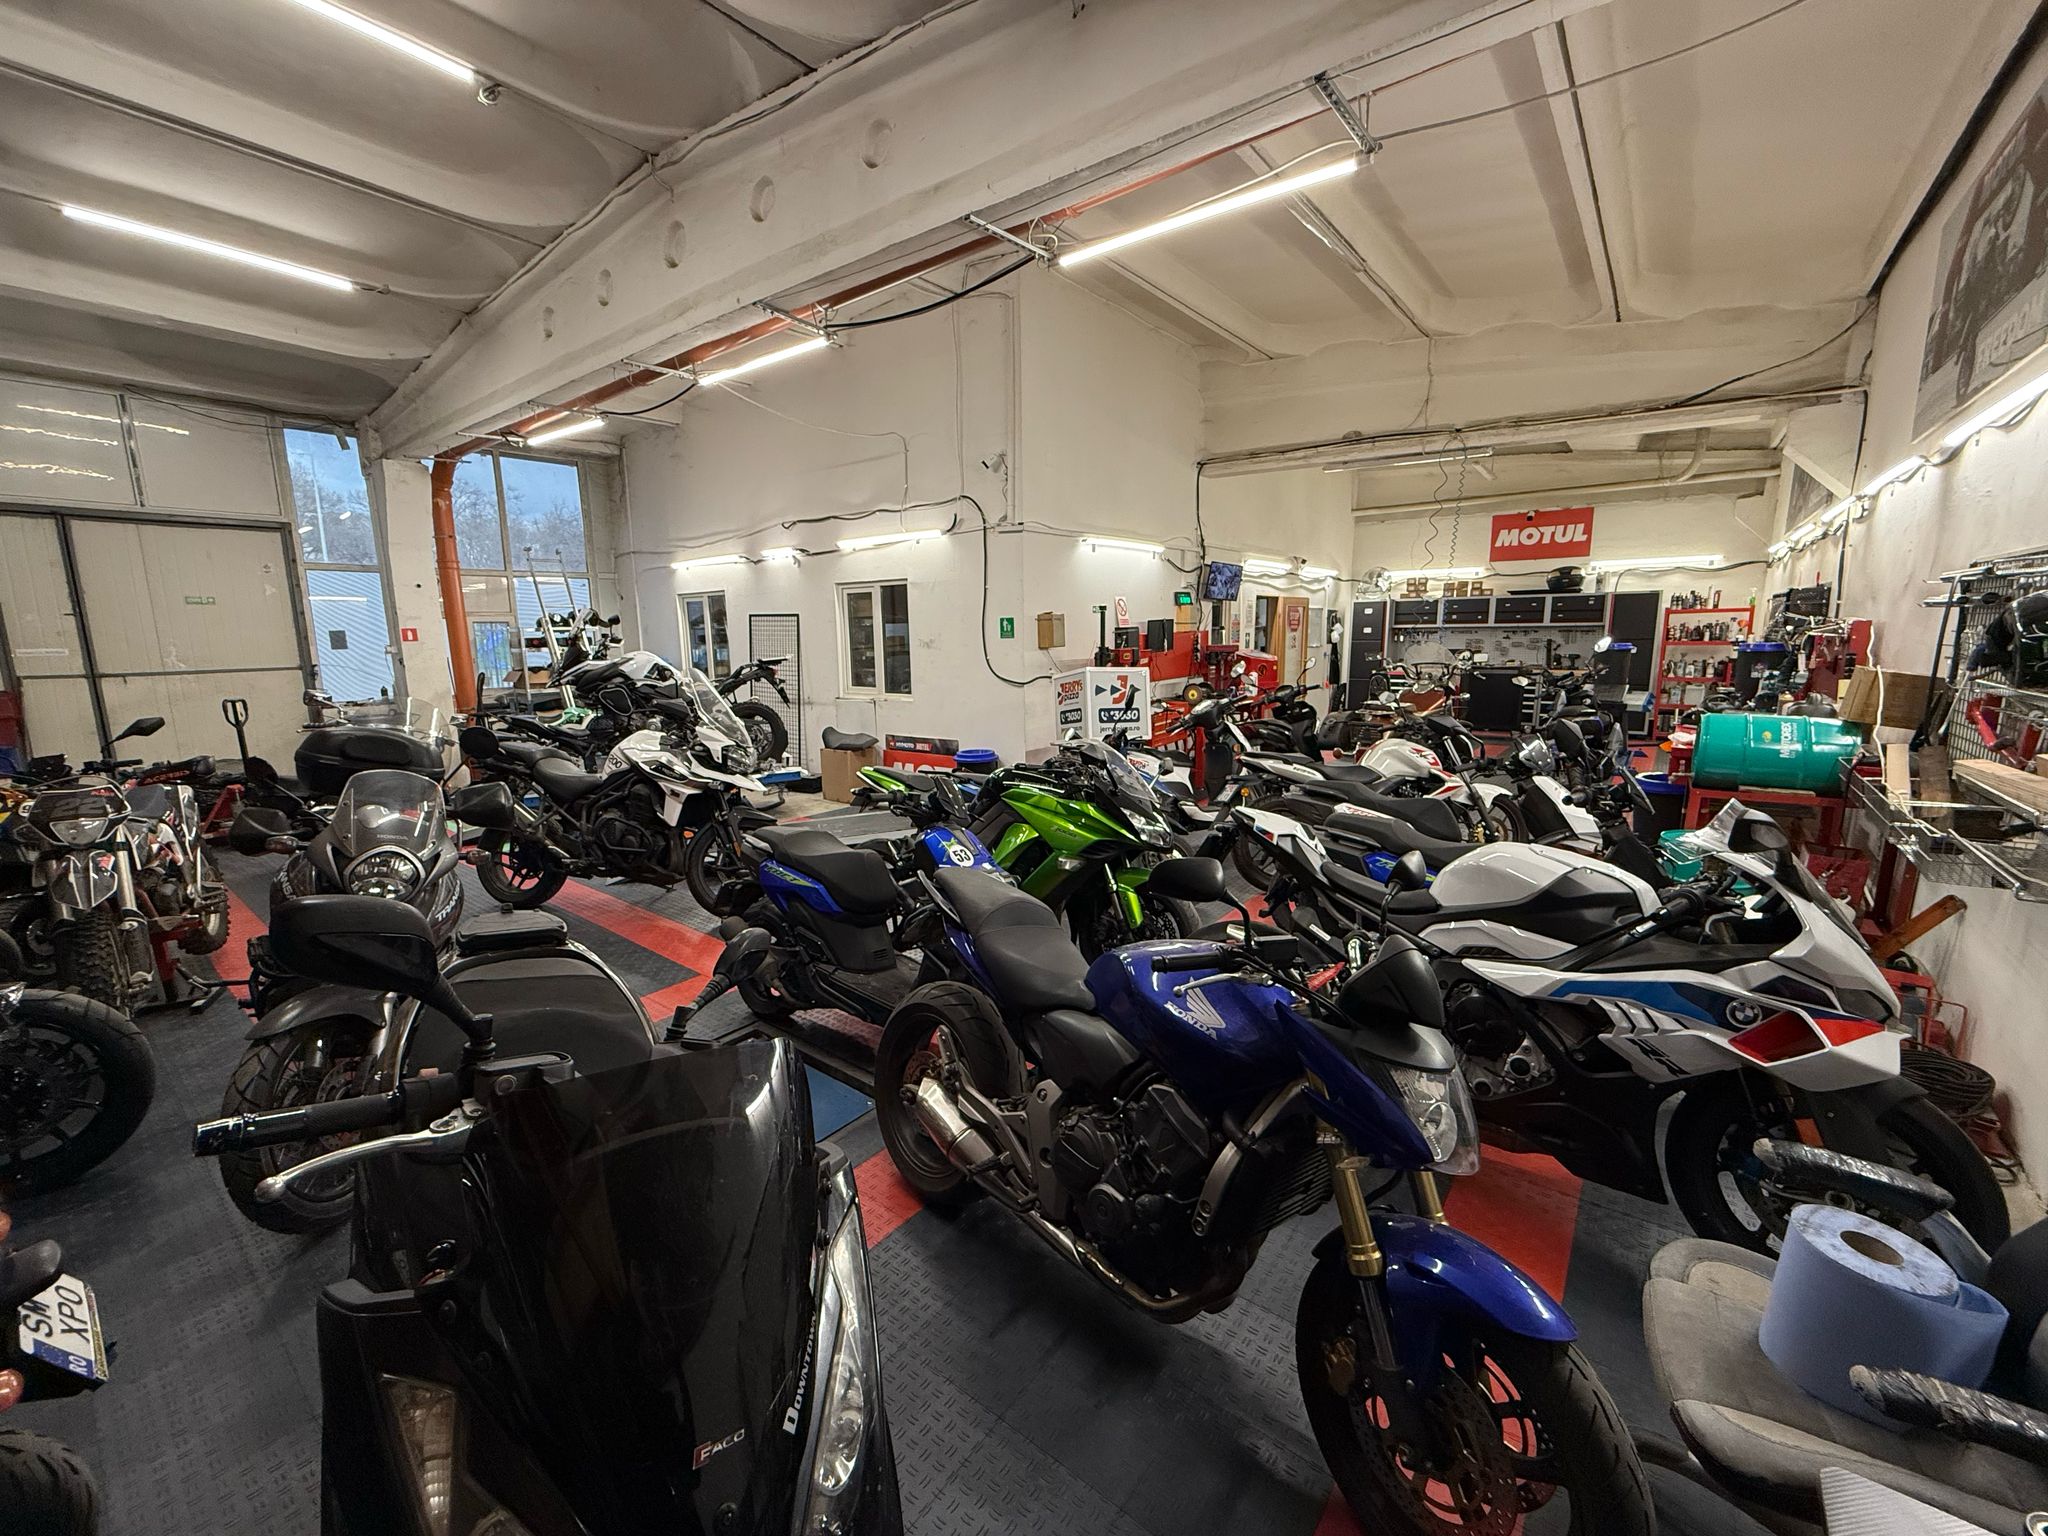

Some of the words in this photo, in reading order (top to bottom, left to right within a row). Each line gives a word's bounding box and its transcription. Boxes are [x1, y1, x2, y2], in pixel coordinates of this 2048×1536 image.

[1494, 523, 1588, 548] MOTUL
[952, 849, 971, 863] 53
[1163, 1000, 1218, 1041] HONDA
[54, 1285, 91, 1344] XPO
[68, 1354, 89, 1376] RO
[782, 1311, 817, 1435] DOWNTOWN
